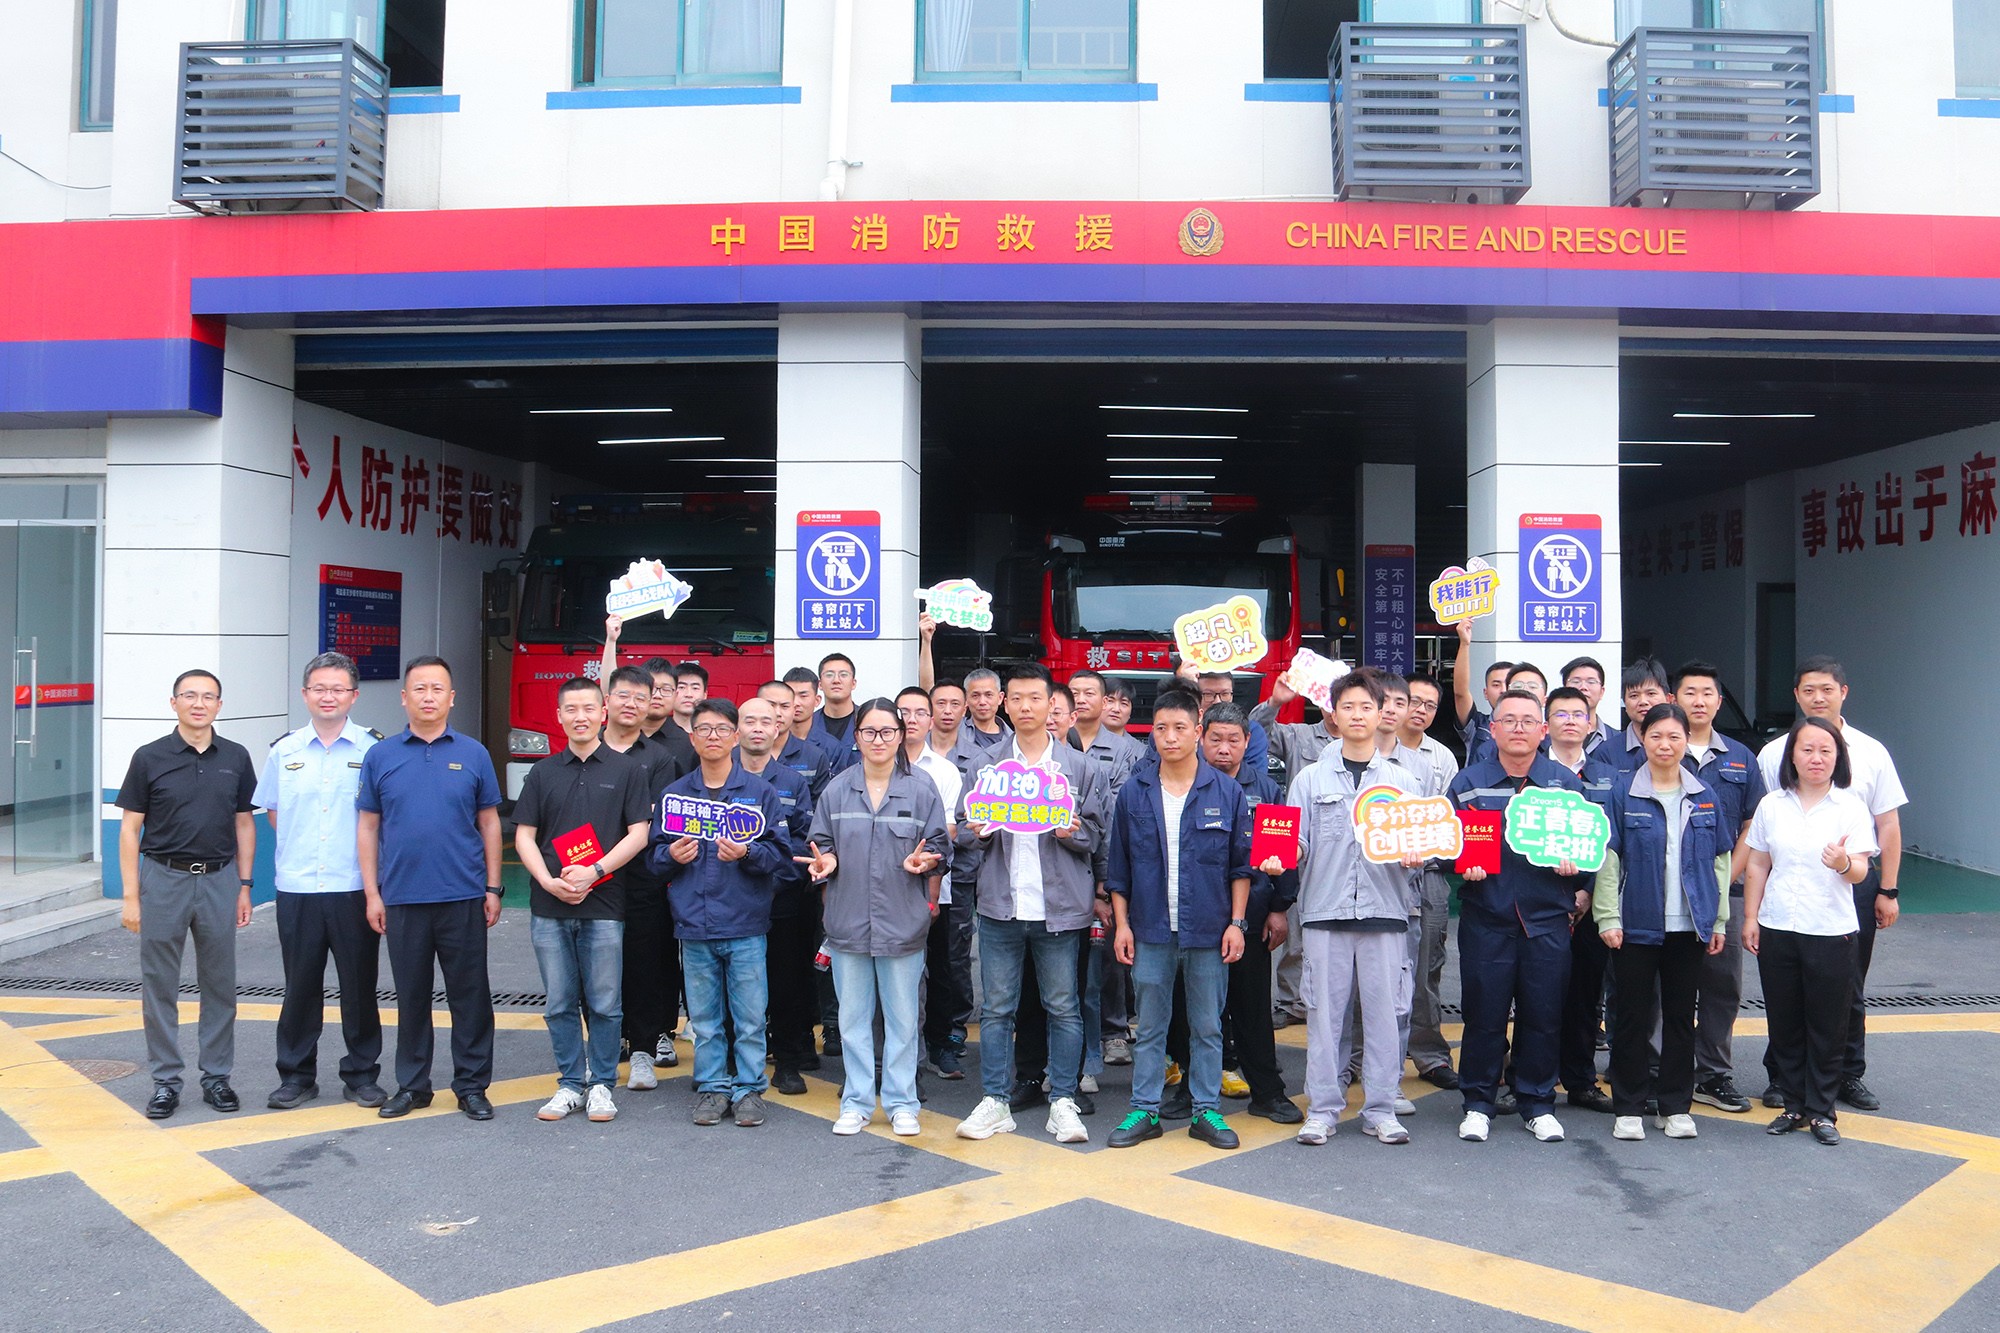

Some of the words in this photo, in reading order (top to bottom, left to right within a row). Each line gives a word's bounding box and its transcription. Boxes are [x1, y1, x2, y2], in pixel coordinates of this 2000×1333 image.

[711, 212, 1114, 255] 中国消防救援
[1285, 221, 1388, 249] CHINA
[1393, 224, 1468, 251] FIRE
[1475, 226, 1545, 253] AND
[1551, 227, 1688, 255] RESCUE
[1802, 451, 1998, 557] 事故出于麻
[1436, 574, 1491, 603] 我能行
[811, 603, 866, 615] 卷帘门下
[929, 606, 990, 628] 放飞梦想
[1443, 602, 1465, 617] DO
[1533, 605, 1587, 618] 卷帘门下
[811, 617, 866, 629] 禁止站人
[1183, 613, 1236, 646] 超凡
[1391, 568, 1404, 678] 不可粗心和大意
[1533, 619, 1587, 632] 禁止站人
[1086, 646, 1111, 668] 救
[1206, 630, 1257, 664] 团队
[534, 672, 576, 680] HOWO
[583, 660, 602, 680] 救
[980, 767, 1040, 800] 加油
[667, 799, 726, 820] 撸起袖子
[970, 802, 1070, 825] 你是最棒的
[1369, 802, 1448, 827] 争分夺秒
[1516, 804, 1596, 836] 正青春
[1368, 821, 1456, 856] 创佳绩
[1463, 825, 1494, 834] 荣誉证书
[1519, 833, 1597, 861] 一起拼
